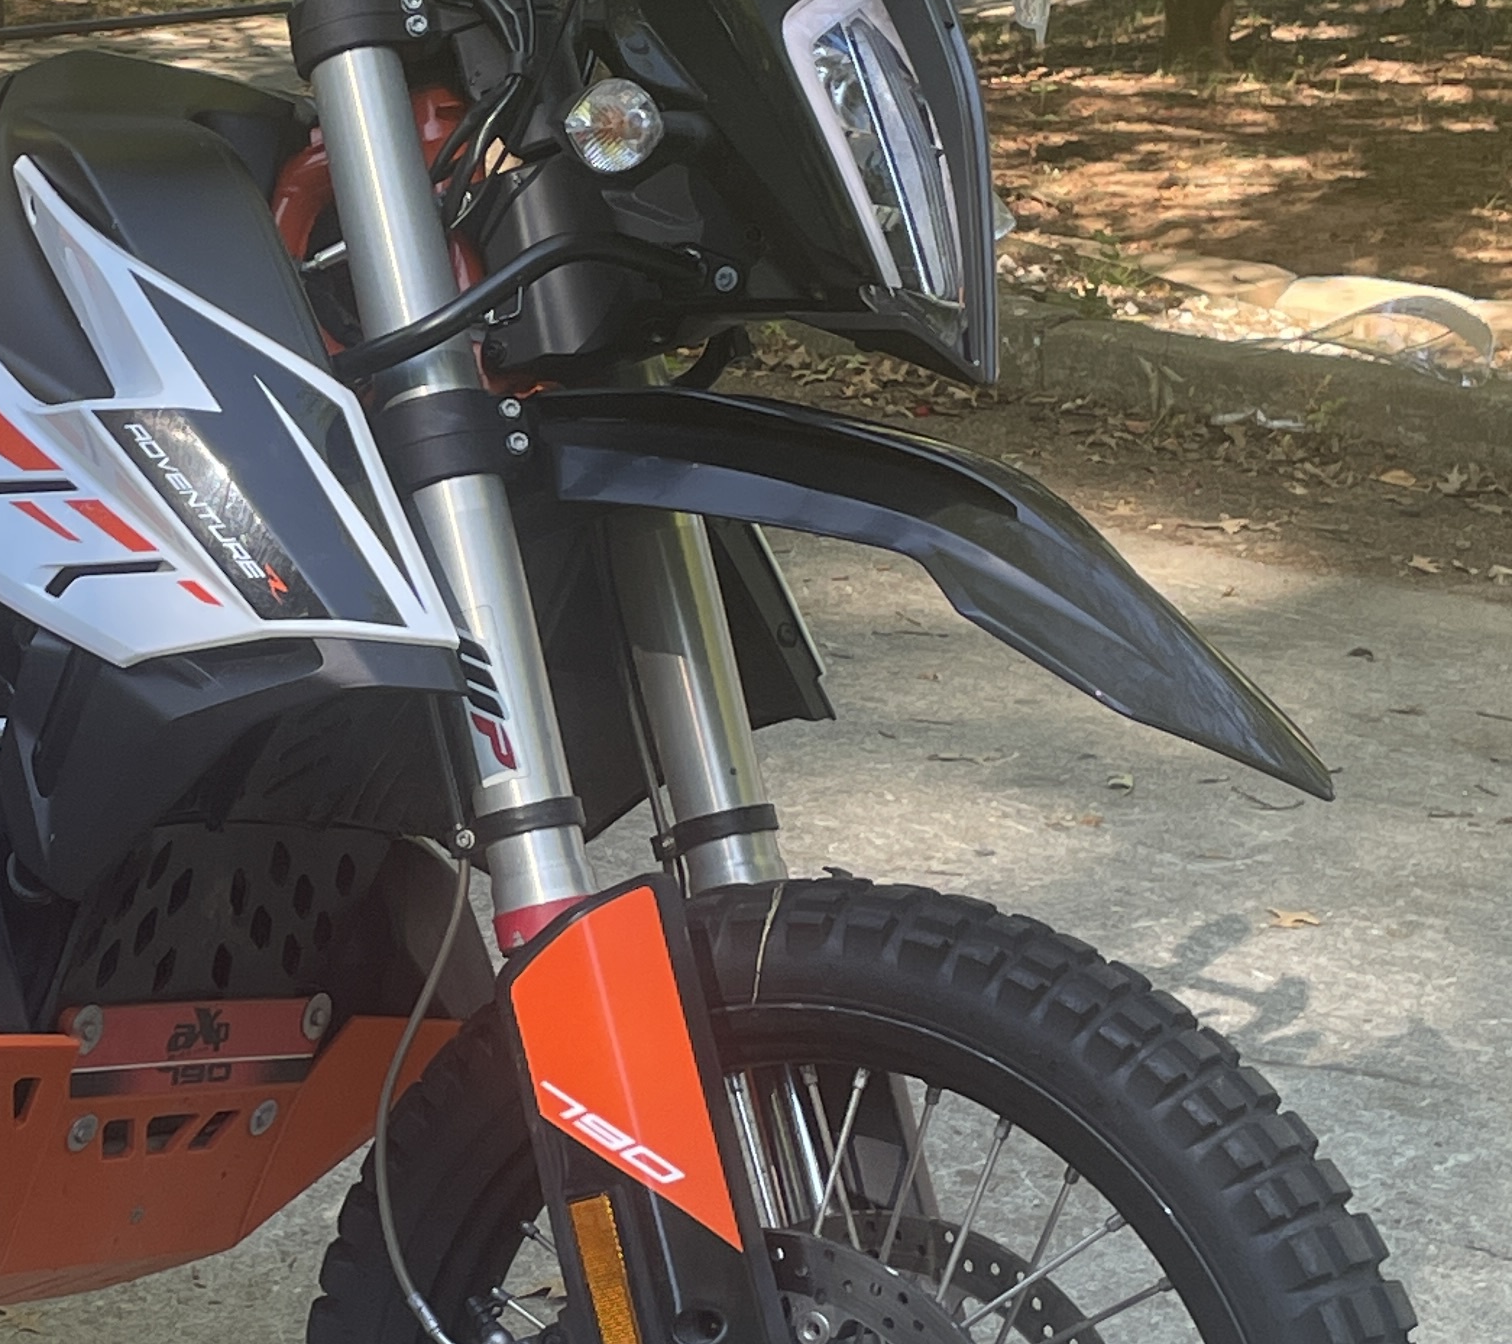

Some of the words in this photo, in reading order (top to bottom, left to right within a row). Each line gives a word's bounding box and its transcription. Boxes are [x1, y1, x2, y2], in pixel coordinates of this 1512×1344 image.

[123, 423, 266, 579] ADVENTURE
[155, 1061, 233, 1087] 790
[539, 1079, 686, 1185] 790
